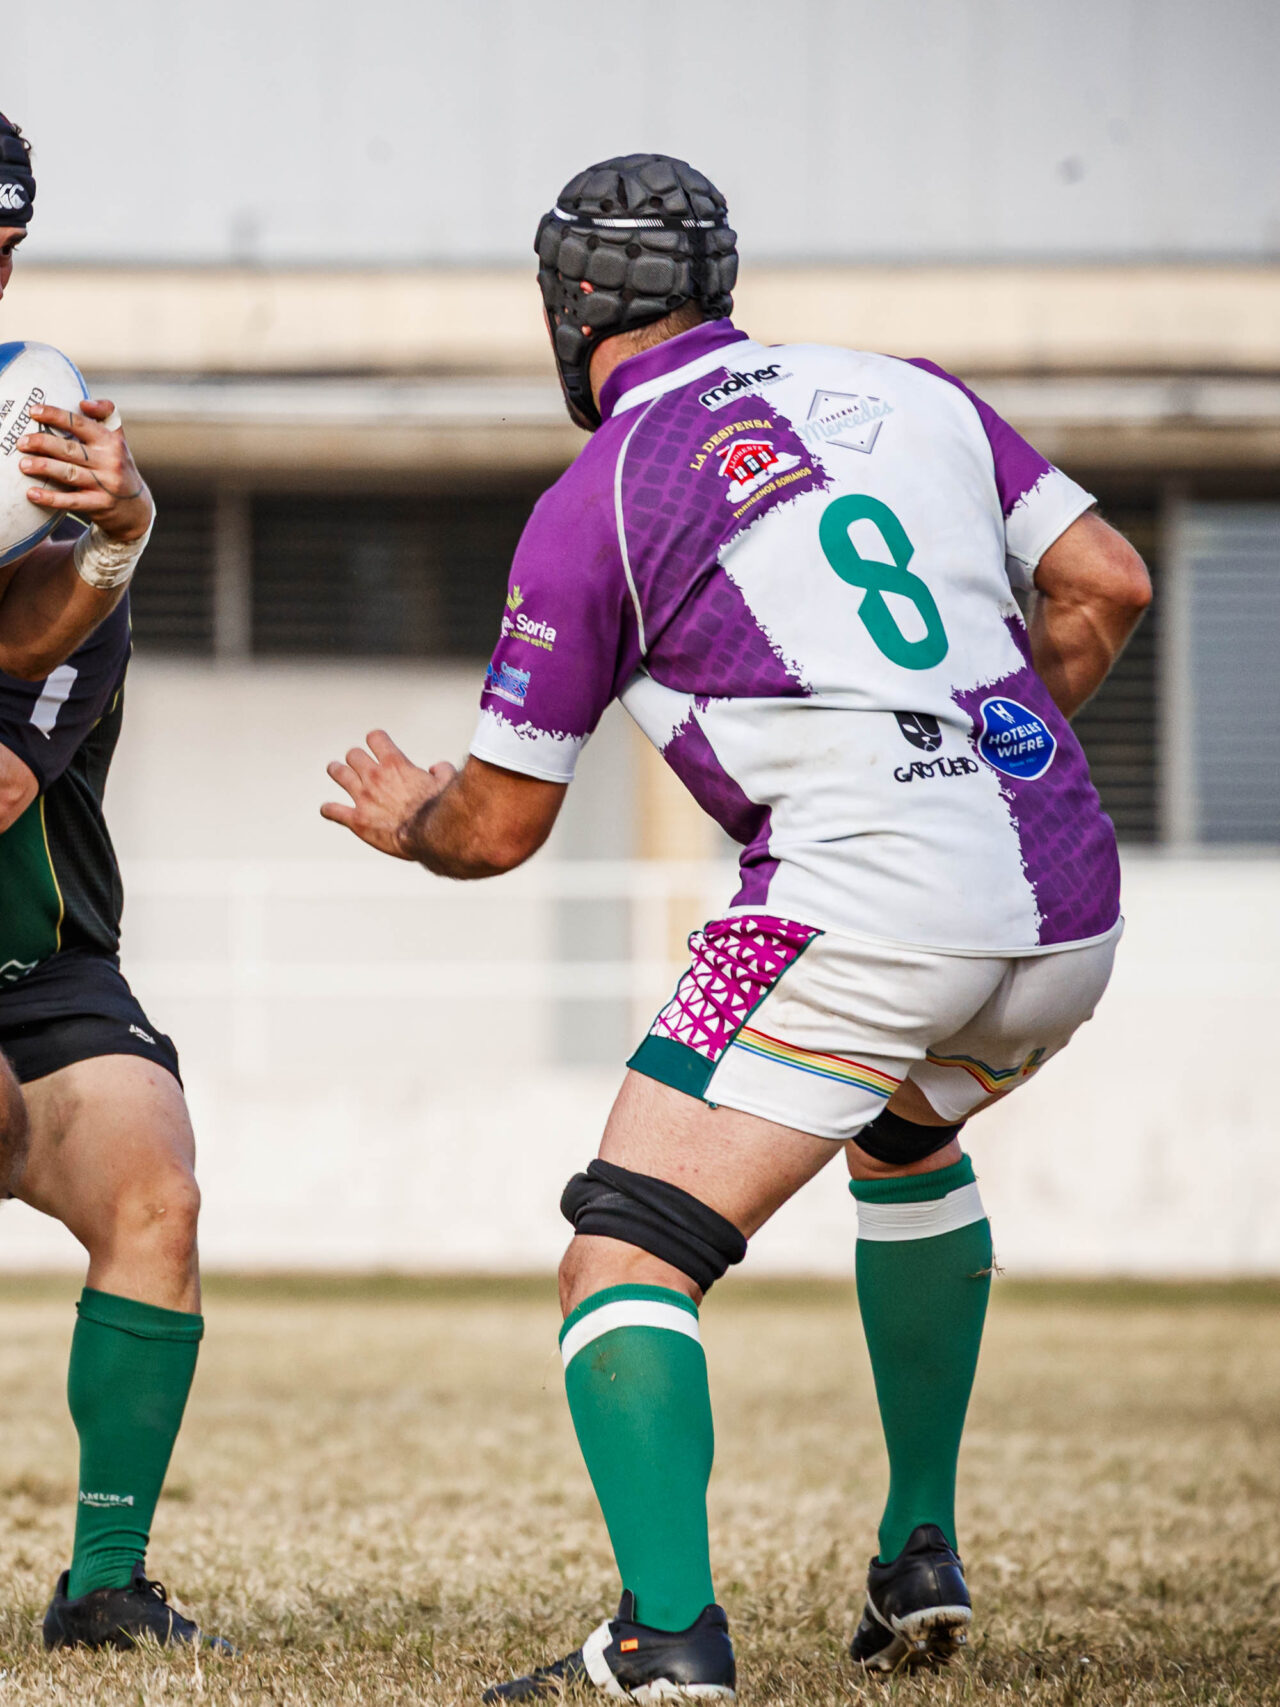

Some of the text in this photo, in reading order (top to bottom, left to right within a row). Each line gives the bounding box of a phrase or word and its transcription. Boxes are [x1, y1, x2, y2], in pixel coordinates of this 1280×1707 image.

[820, 405, 860, 424] TABERNA
[690, 419, 773, 472] LA DESPENSA
[728, 445, 763, 470] LLORENTE
[776, 467, 812, 489] SORIANOS
[819, 494, 949, 671] 8
[516, 613, 557, 643] Soria
[988, 721, 1043, 745] HOTELES
[997, 736, 1045, 758] WIFRE
